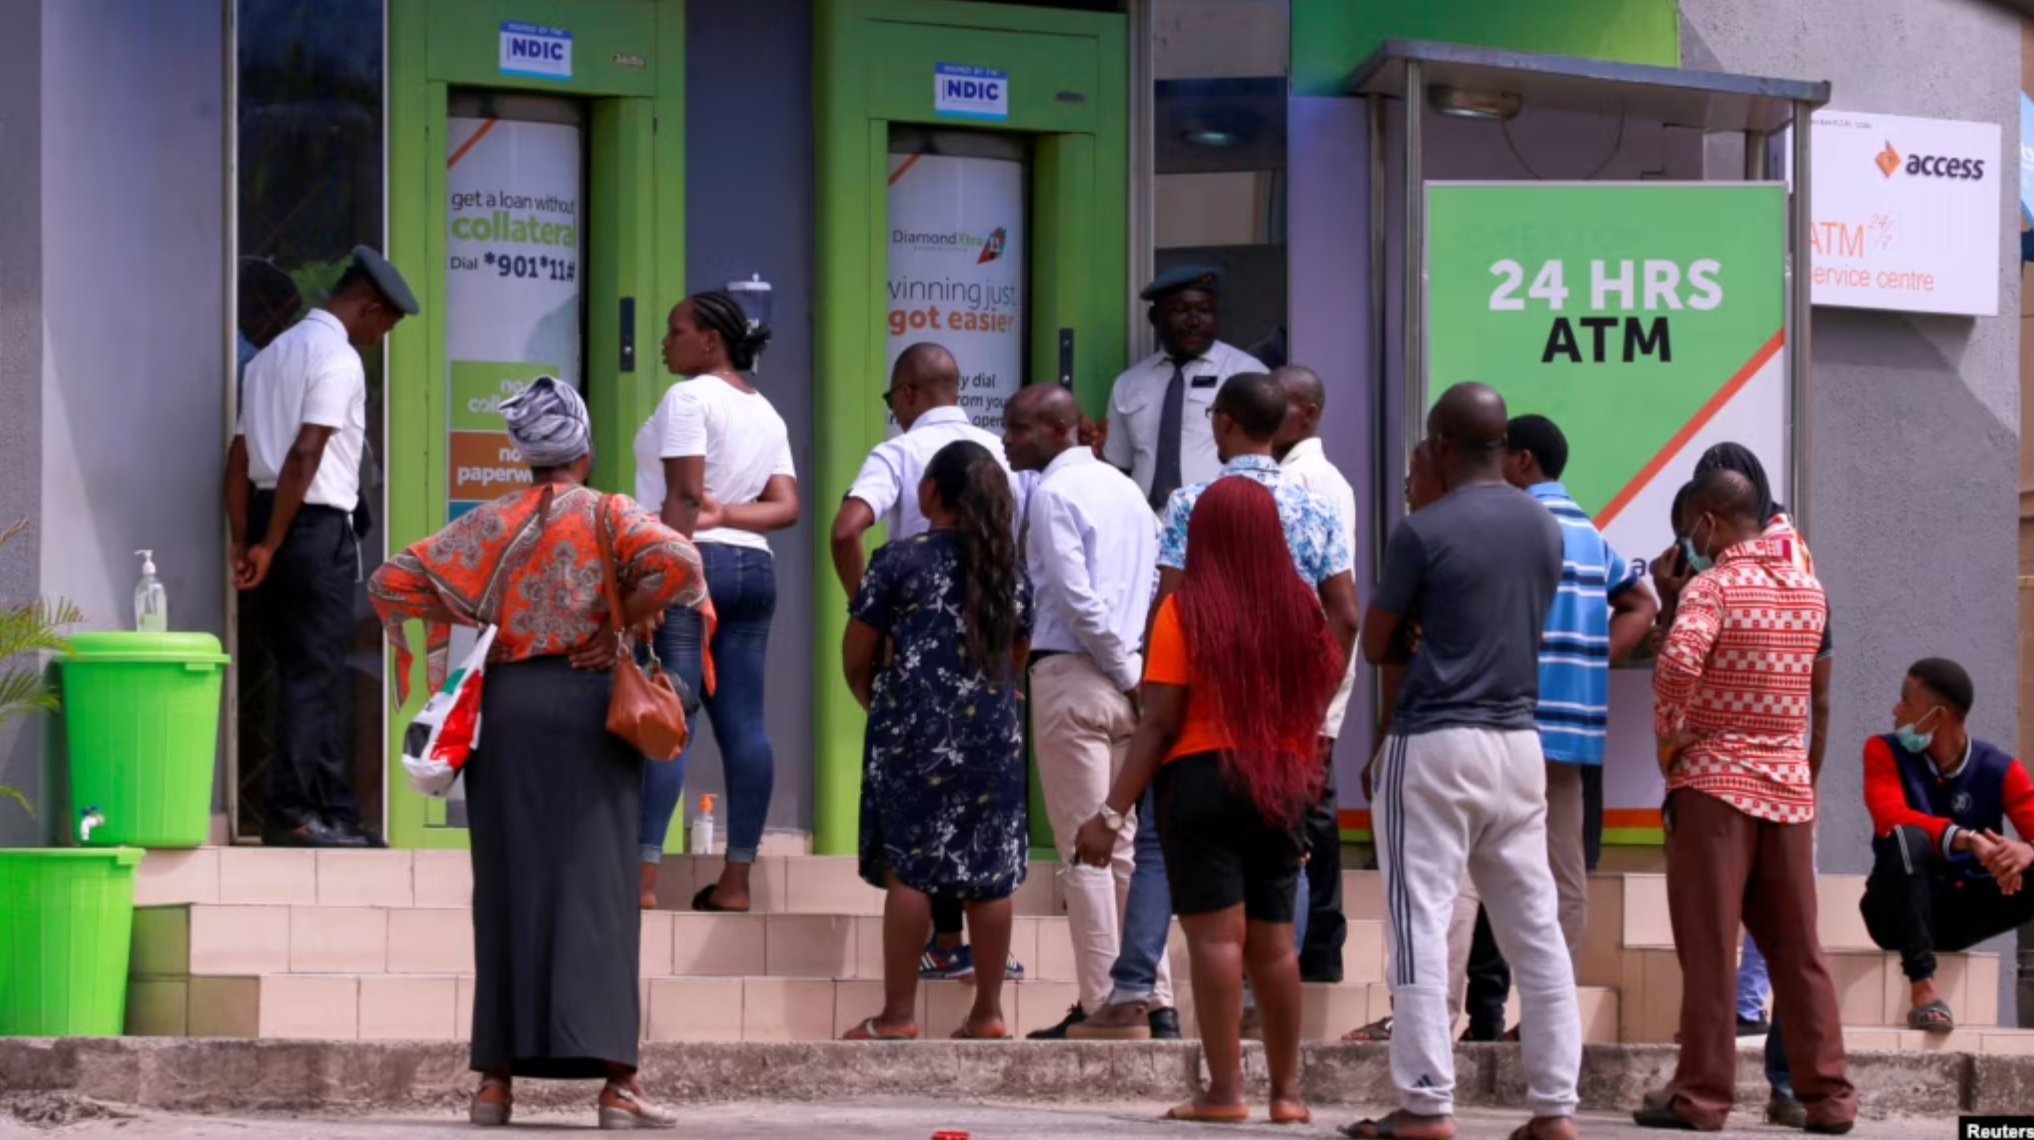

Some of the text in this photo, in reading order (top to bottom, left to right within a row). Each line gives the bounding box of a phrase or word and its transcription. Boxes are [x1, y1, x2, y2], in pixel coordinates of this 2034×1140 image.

[512, 38, 564, 61] NDIC
[947, 79, 999, 101] NDIC
[1906, 153, 1985, 181] access
[451, 190, 483, 211] get
[486, 193, 496, 208] a
[500, 190, 534, 209] loan
[450, 255, 478, 270] Dial
[1489, 258, 1723, 310] 24 HRS
[1812, 264, 1934, 291] ervice centre
[983, 279, 1017, 310] just
[888, 304, 1014, 336] got easier
[1541, 316, 1671, 362] ATM
[972, 372, 996, 388] dial
[957, 395, 983, 407] rom
[499, 447, 522, 462] no
[457, 466, 533, 487] paperw
